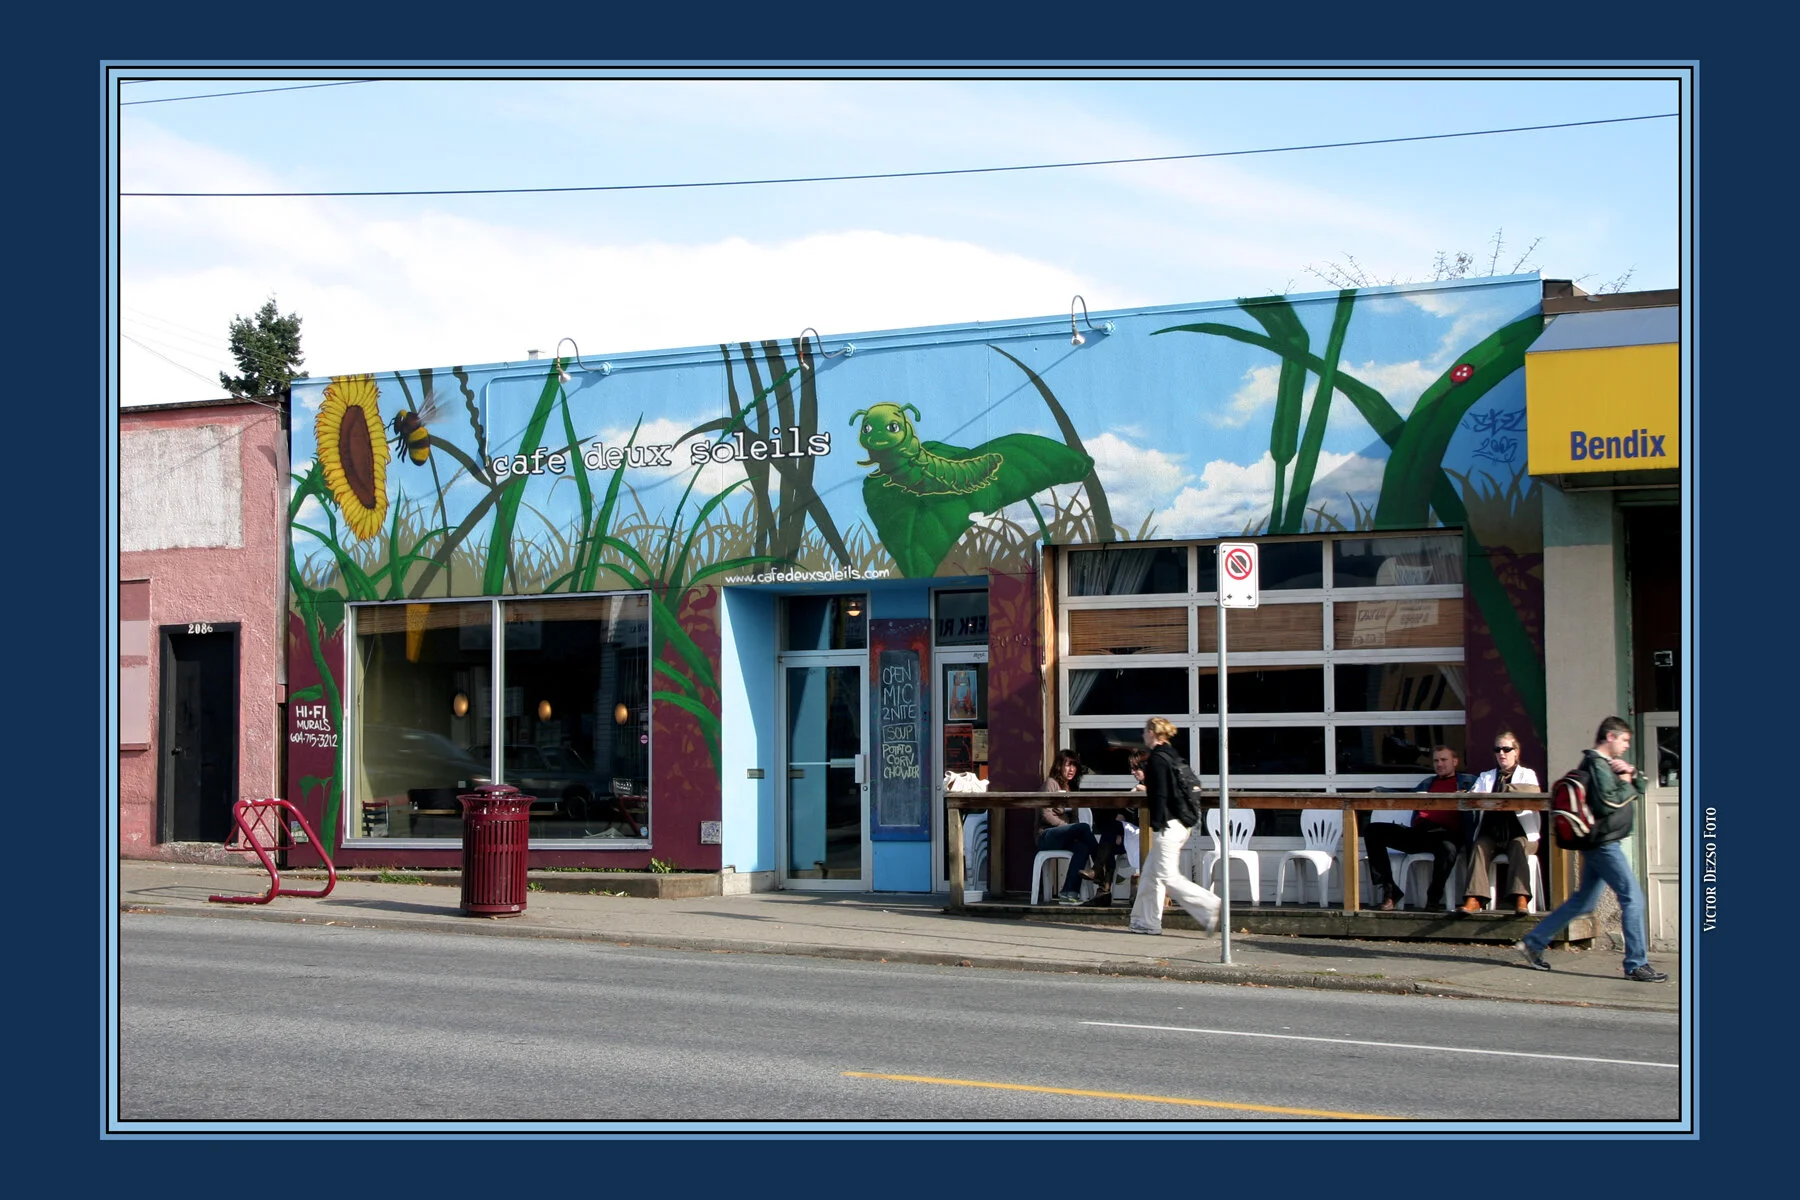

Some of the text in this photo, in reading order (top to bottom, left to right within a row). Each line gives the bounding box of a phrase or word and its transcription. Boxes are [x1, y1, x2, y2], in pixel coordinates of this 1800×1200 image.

[492, 427, 832, 476] cafe deux soleils
[1570, 428, 1667, 461] Bendix
[725, 565, 890, 584] www.cafedeuxsoleils.com
[187, 622, 213, 635] 2086
[882, 660, 912, 685] OPEN
[883, 684, 913, 706] MIC
[882, 704, 917, 721] 2NITE
[296, 718, 331, 731] MURALS
[887, 724, 913, 740] SOUP
[290, 731, 338, 747] 604-715-3212
[886, 753, 914, 767] CORN
